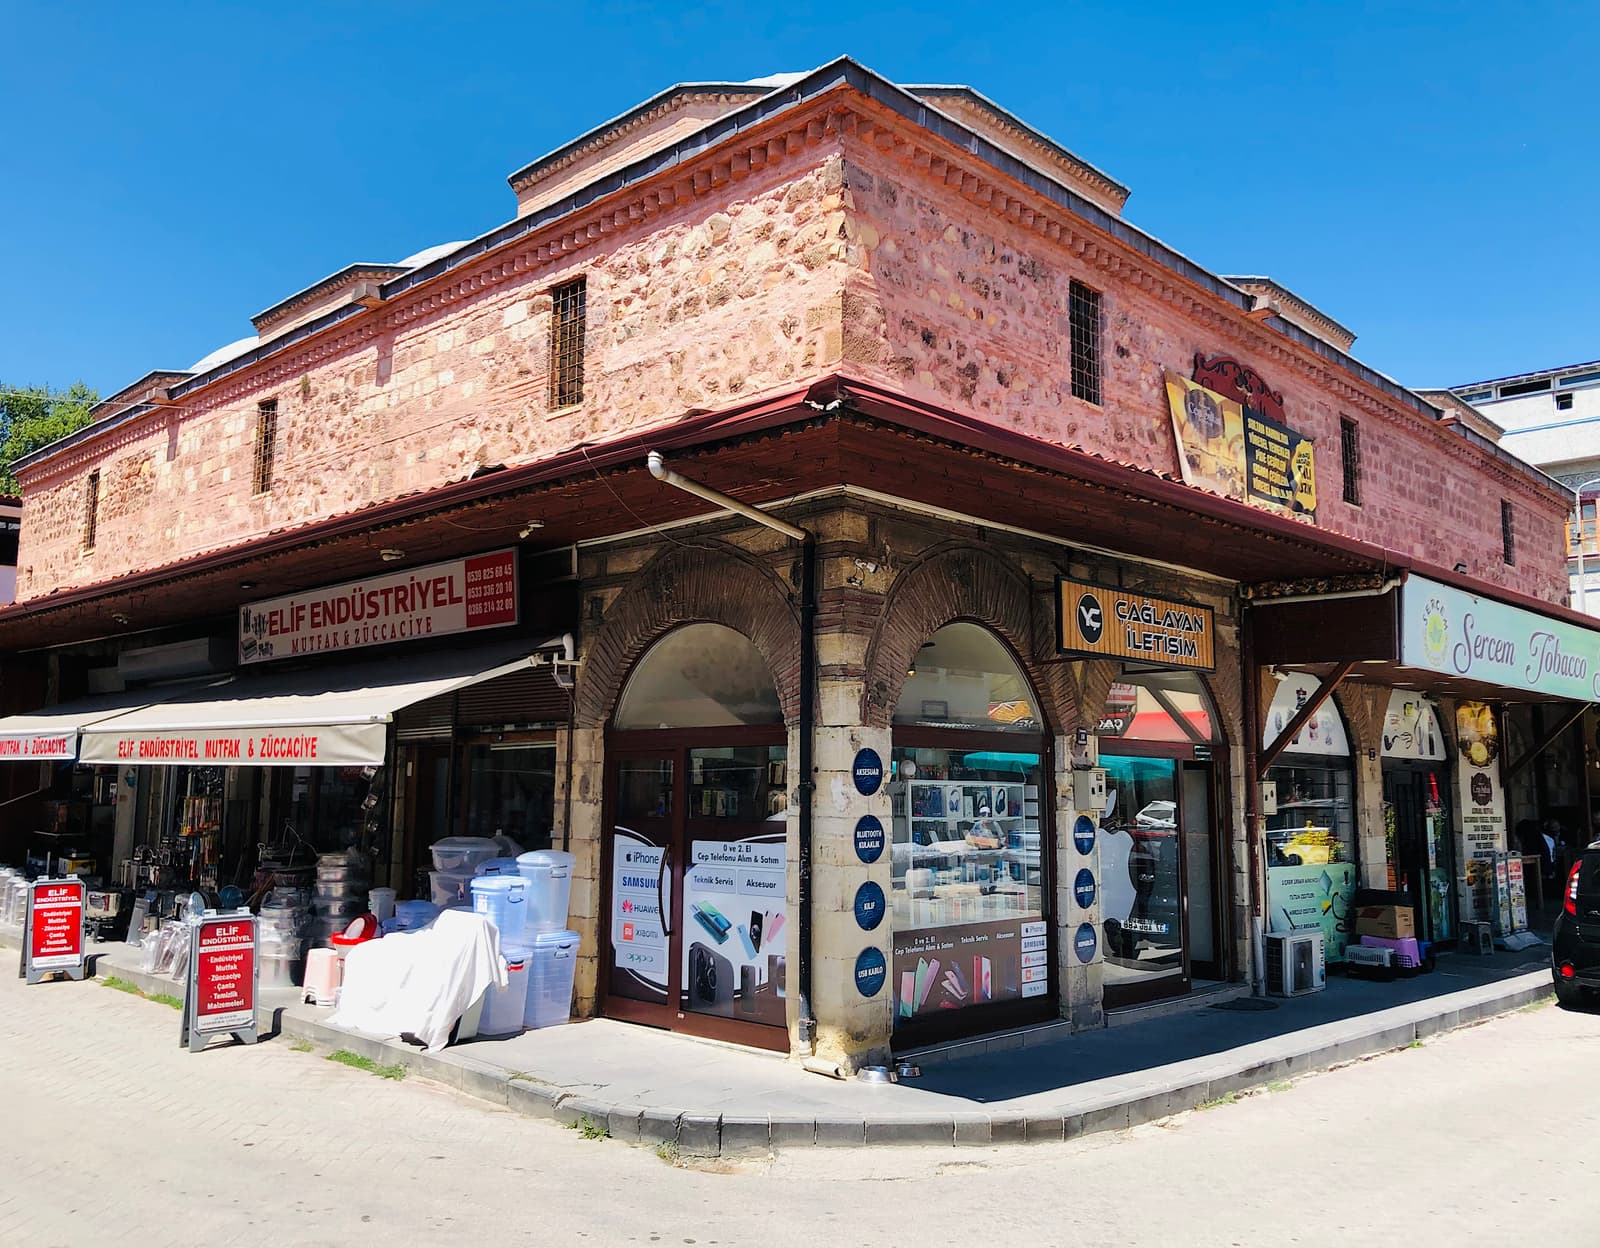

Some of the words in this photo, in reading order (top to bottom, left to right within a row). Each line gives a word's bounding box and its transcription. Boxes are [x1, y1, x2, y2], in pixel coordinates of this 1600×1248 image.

[504, 563, 512, 575] 45
[504, 580, 513, 593] 10
[268, 601, 306, 636] ELİF
[310, 575, 463, 628] ENDÜSTRİYEL
[483, 600, 495, 613] 214
[1114, 598, 1204, 634] ÇAĞLAYAN
[291, 631, 340, 655] MUTFAK
[343, 630, 350, 645] &
[354, 615, 432, 644] ZÜCCACİYE
[1126, 624, 1199, 663] İLETİŞİM
[1453, 613, 1516, 673] Sercem
[1525, 631, 1587, 684] Tobacco
[24, 739, 29, 754] &
[31, 736, 67, 755] ZÜCCACİYE
[118, 736, 134, 759] ELİF
[139, 735, 199, 759] ENDÜRSTRİYEL
[205, 737, 241, 759] MUTFAK
[248, 738, 254, 757] &
[260, 733, 318, 758] ZÜCCACİYE
[856, 768, 879, 776] AKSESUAR
[633, 852, 660, 865] iPhone
[697, 852, 709, 862] Cep
[710, 852, 736, 862] Telefonu
[737, 854, 752, 863] Alım
[753, 855, 759, 863] &
[760, 855, 779, 865] Satım
[622, 876, 660, 889] SAMSUN
[694, 875, 714, 885] Teknik
[715, 876, 734, 887] Servis
[746, 879, 777, 889] Aksesuar
[48, 887, 69, 897] ELİF
[36, 895, 80, 904] ENDÜSTRİYEL
[634, 904, 660, 914] HUAWE
[216, 925, 239, 937] ELİF
[202, 935, 252, 946] ENDÜSTRİYEL
[961, 936, 975, 944] Teknik
[895, 947, 904, 956] Cep
[210, 953, 244, 964] Endüstriyel
[215, 964, 238, 972] Mutfak
[858, 970, 867, 978] USB
[211, 973, 242, 982] Züccaciye
[217, 983, 235, 992] Çanta
[213, 991, 238, 1000] Temizlik
[207, 998, 245, 1010] Malzemeleri
